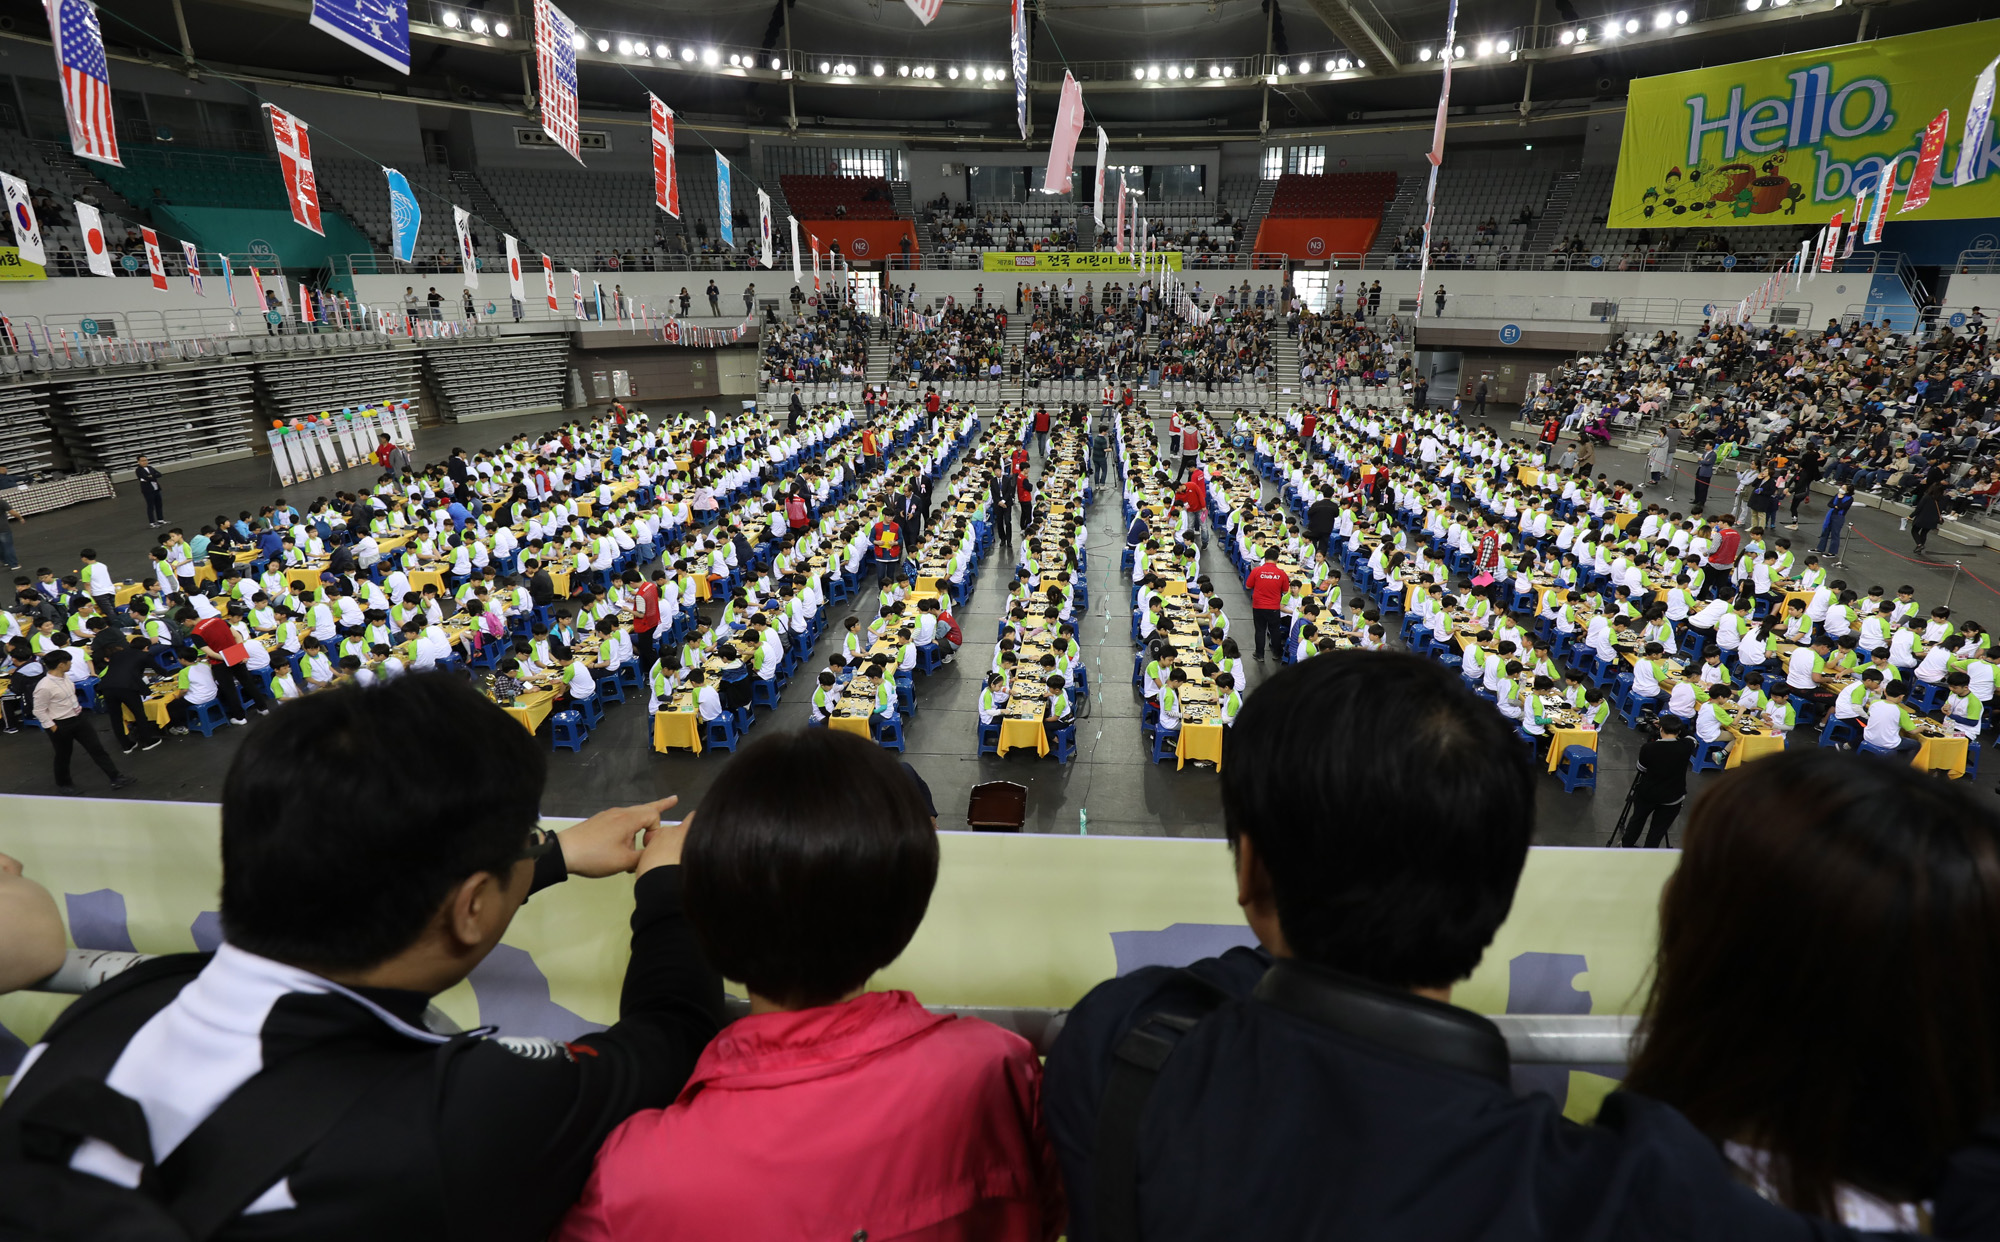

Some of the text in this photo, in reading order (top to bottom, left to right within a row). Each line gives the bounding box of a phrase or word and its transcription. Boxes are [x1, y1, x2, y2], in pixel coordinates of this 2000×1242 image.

[1686, 65, 1895, 165] Hello,
[251, 245, 270, 254] W3
[855, 242, 866, 250] N2
[1975, 240, 1993, 250] E2
[1047, 254, 1070, 267] 전국
[1076, 254, 1112, 267] 어린이
[1504, 328, 1516, 337] E1
